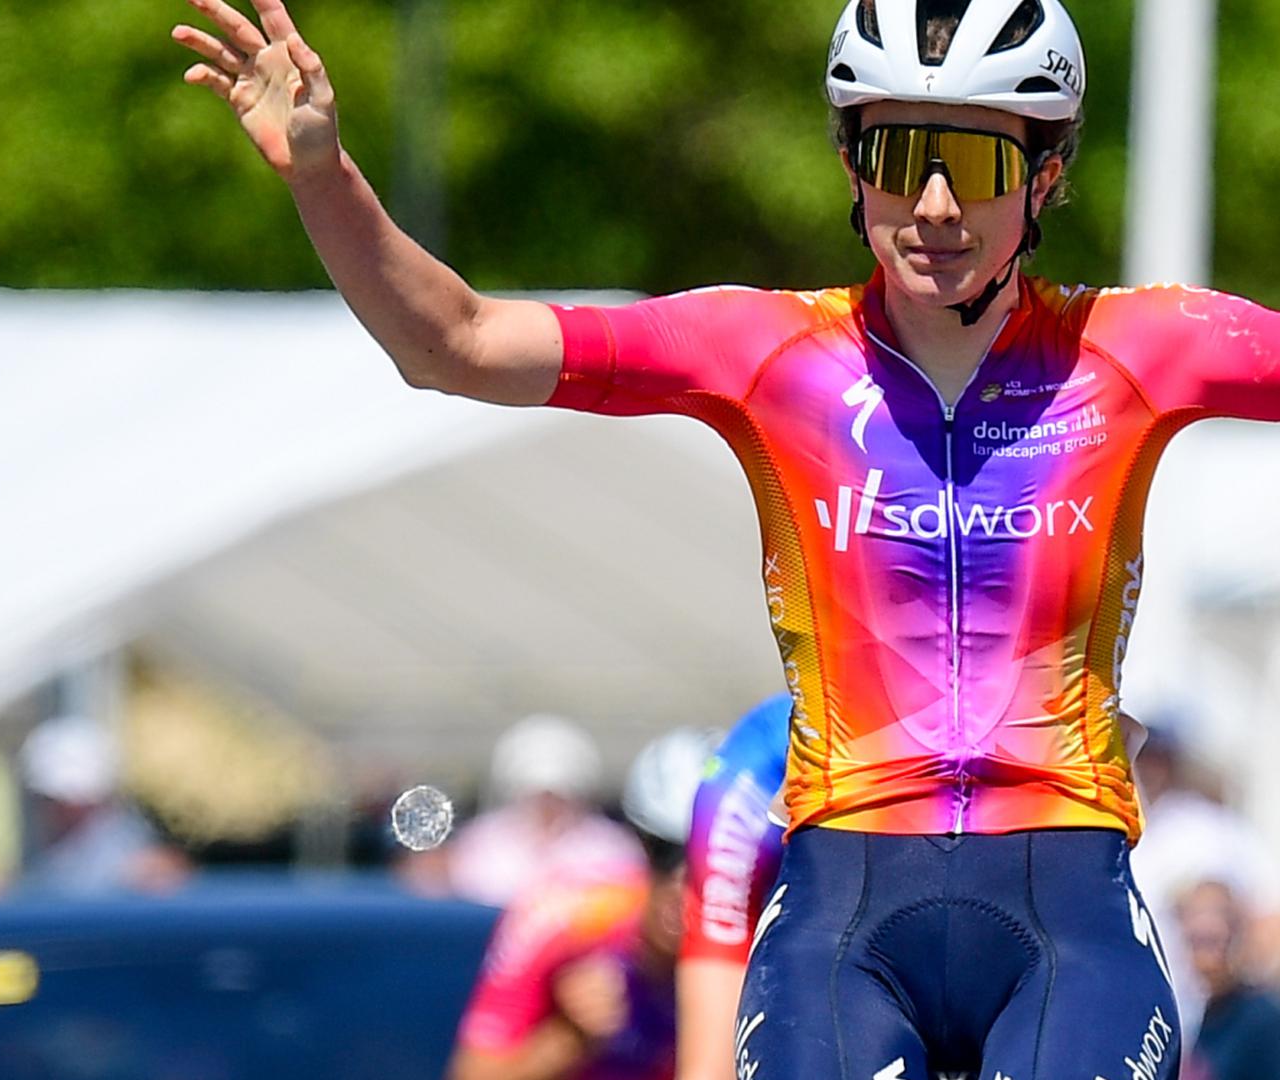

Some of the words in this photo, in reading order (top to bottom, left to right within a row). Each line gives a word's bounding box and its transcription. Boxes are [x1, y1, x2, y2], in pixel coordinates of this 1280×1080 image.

[973, 421, 1068, 440] dolmans
[973, 442, 1061, 459] landscaping
[1064, 431, 1108, 453] group
[882, 489, 1094, 539] sdworx
